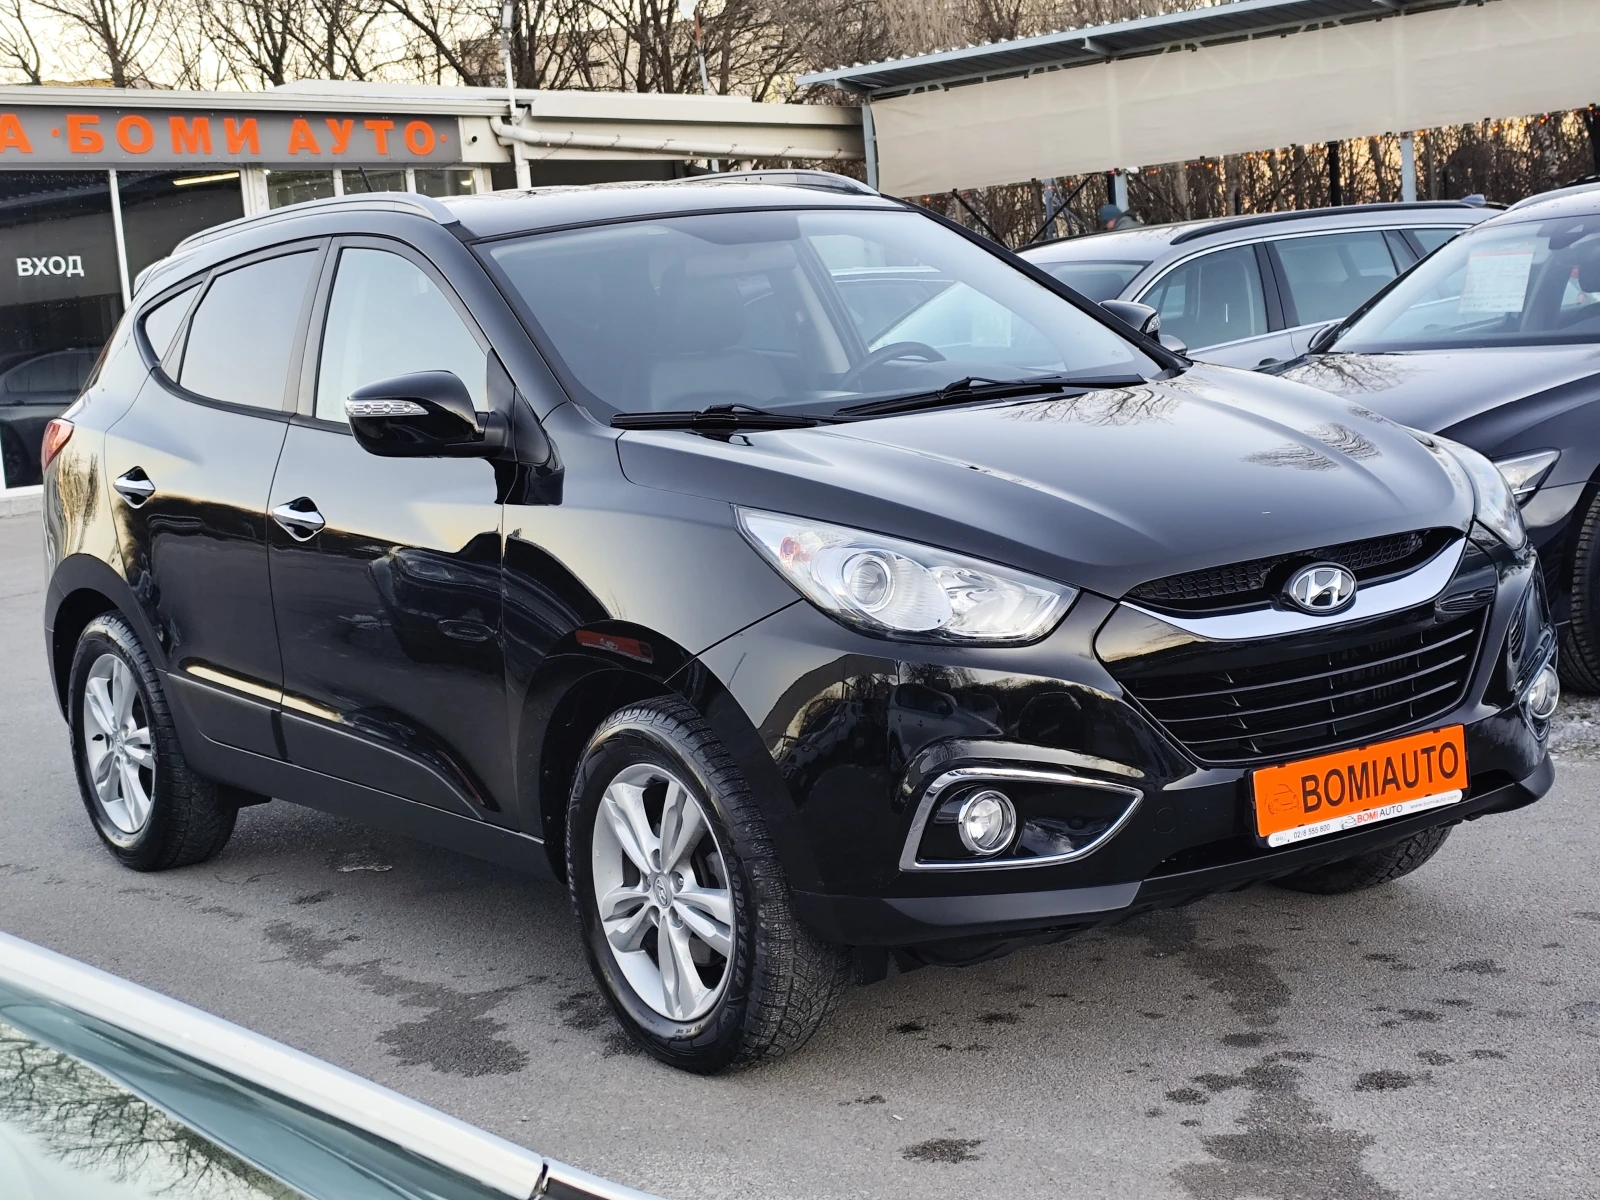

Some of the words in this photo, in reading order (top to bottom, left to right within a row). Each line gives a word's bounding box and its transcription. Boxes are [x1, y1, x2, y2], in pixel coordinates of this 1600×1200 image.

[65, 113, 261, 154] БОМИ
[287, 117, 436, 156] АУТО
[16, 255, 85, 278] ВХОД
[1301, 741, 1459, 814] BOMIAUTO
[1356, 811, 1379, 824] BOMI
[1379, 804, 1403, 817] AUTO
[725, 843, 748, 988] OODYEAR
